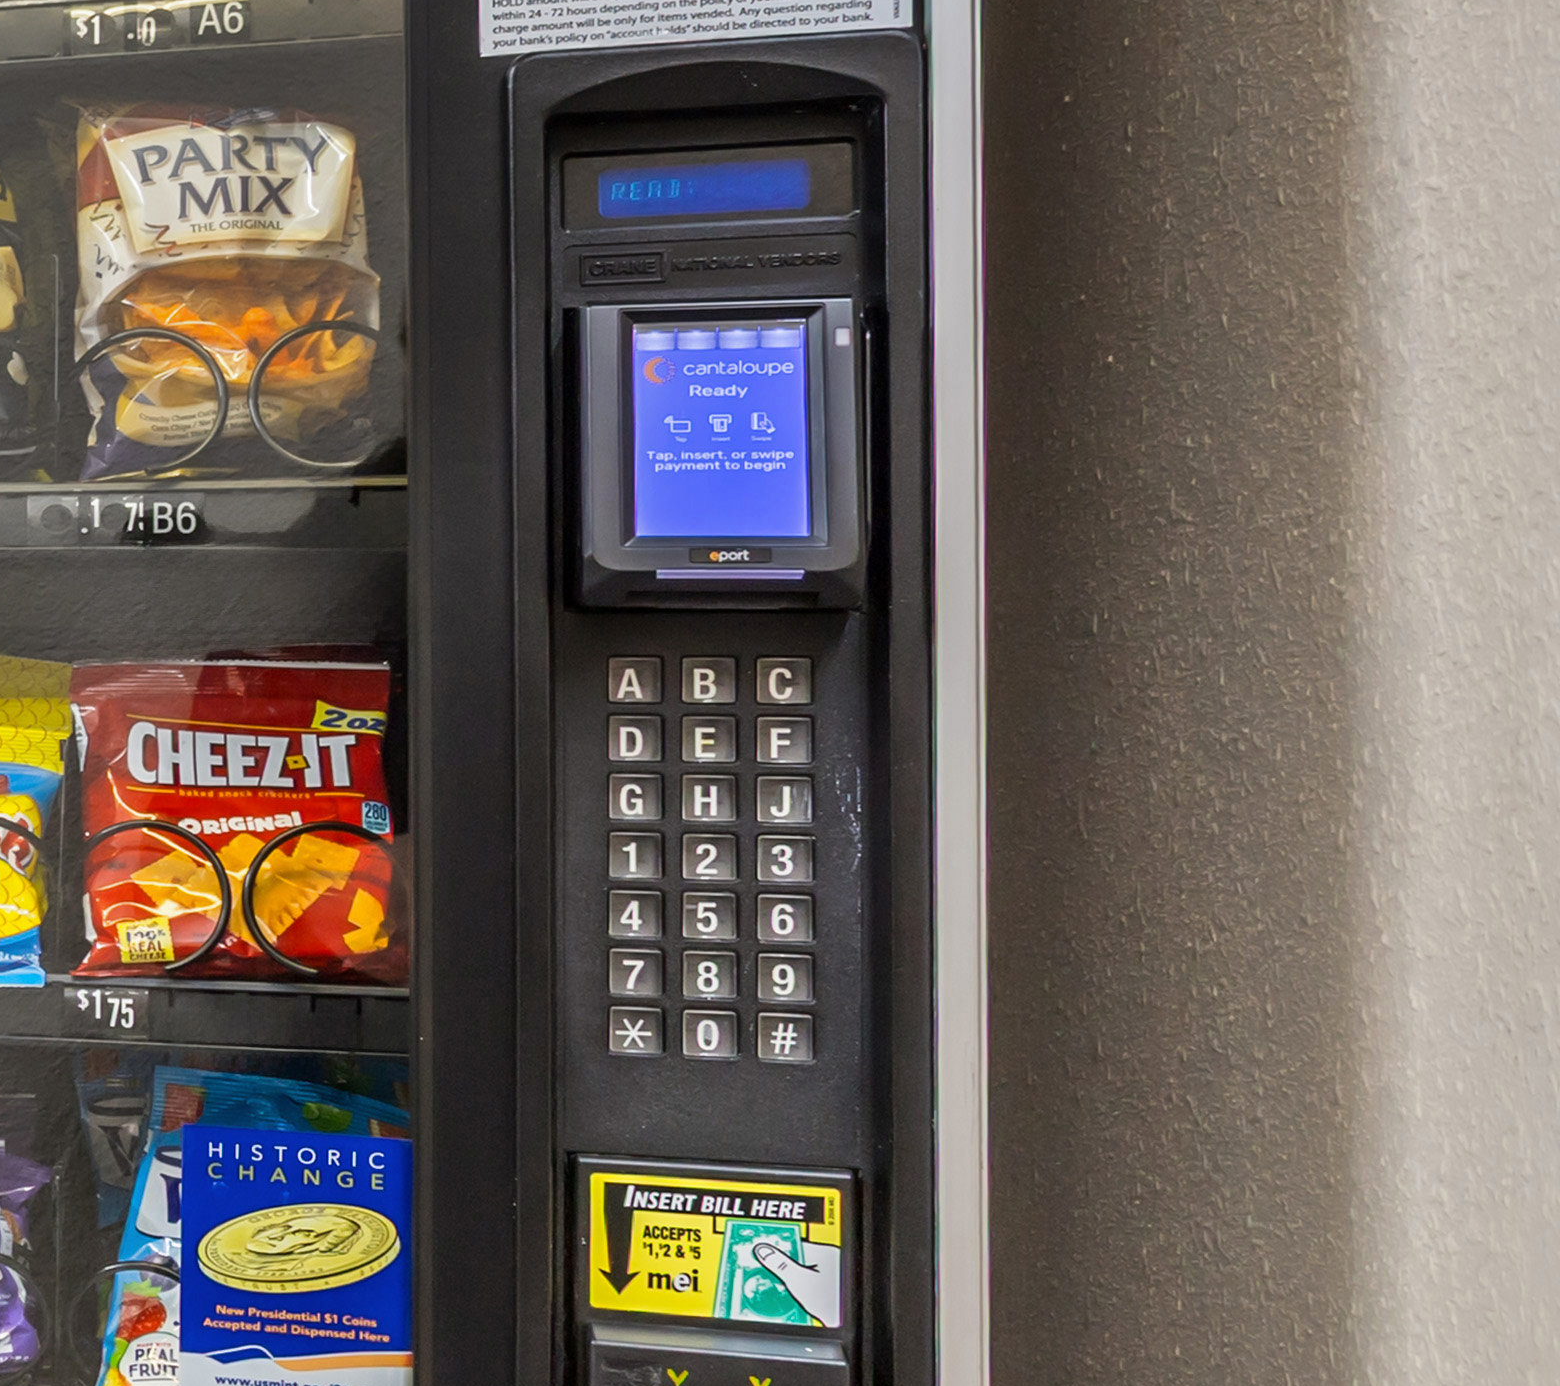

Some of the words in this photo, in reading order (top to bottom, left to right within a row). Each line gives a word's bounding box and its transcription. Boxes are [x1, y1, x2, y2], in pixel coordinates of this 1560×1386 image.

[197, 1, 244, 35] A6
[133, 129, 329, 184] PARTY
[178, 177, 292, 219] MIX
[189, 220, 217, 232] THE
[683, 359, 795, 379] cantaloupe
[689, 383, 749, 400] Ready
[654, 460, 722, 473] payment
[725, 460, 741, 471] to
[744, 459, 787, 473] begin
[152, 501, 197, 534] B6
[209, 1142, 386, 1170] HISTORIC
[208, 1164, 385, 1190] CHANGE
[700, 1195, 745, 1216] BILL
[750, 1199, 806, 1220] HERE
[642, 1225, 702, 1243] ACCEPTS
[215, 1305, 245, 1317] New
[248, 1305, 320, 1323] Presidential
[323, 1312, 338, 1324] $1
[342, 1313, 378, 1328] Coins
[203, 1317, 261, 1332] Accepted
[263, 1322, 288, 1335] and
[290, 1324, 356, 1341] Dispensed
[359, 1329, 391, 1343] Here
